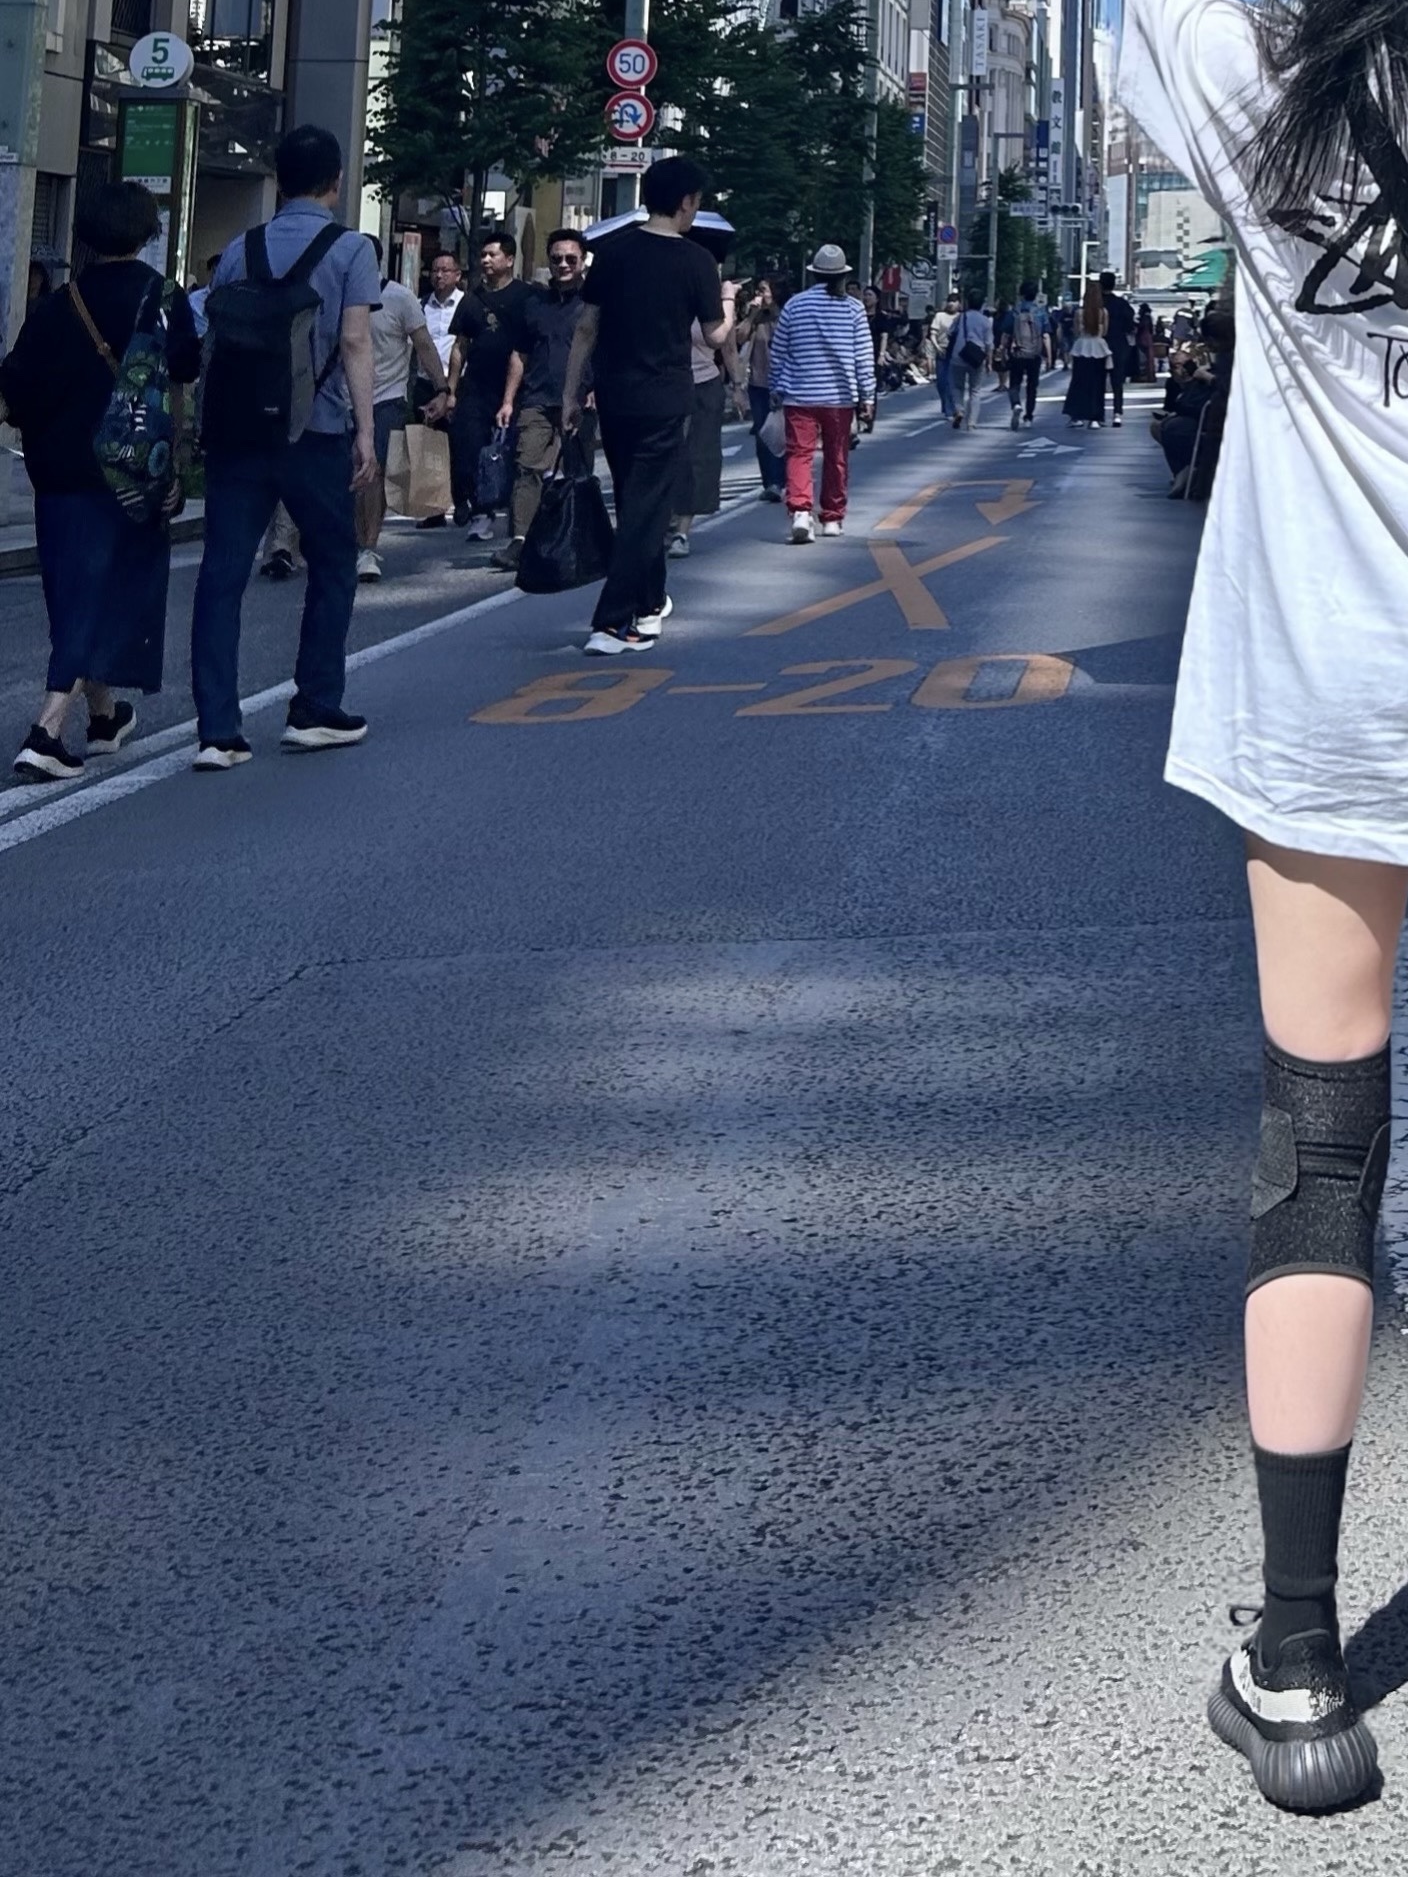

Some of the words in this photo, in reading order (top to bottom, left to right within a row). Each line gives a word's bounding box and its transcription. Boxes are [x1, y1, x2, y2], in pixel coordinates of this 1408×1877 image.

[151, 37, 170, 65] 5
[974, 16, 986, 70] TASAKI
[618, 53, 646, 75] 50
